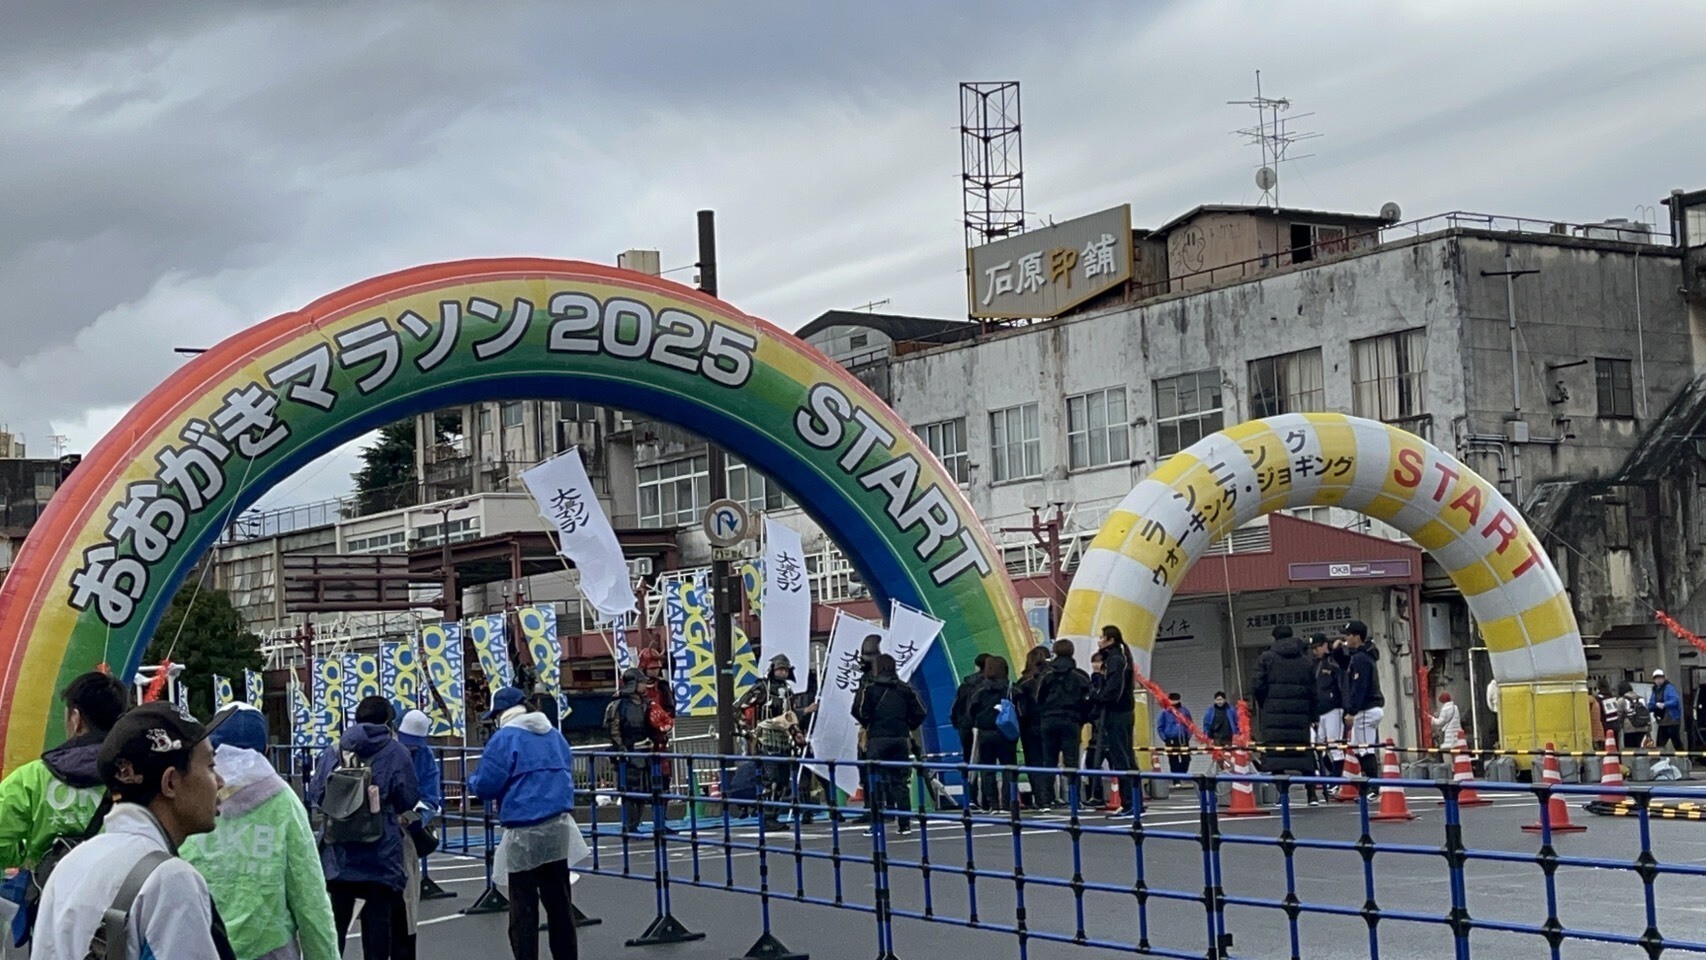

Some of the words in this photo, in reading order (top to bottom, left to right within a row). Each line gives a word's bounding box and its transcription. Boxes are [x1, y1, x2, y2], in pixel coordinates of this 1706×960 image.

[69, 297, 535, 628] おおがきマラソン
[547, 291, 757, 388] 2025
[794, 383, 992, 587] START
[1140, 429, 1307, 546] ランニング
[1152, 455, 1355, 587] ウォーキング・ジョギング
[1393, 448, 1545, 579] START
[382, 645, 396, 703] MARA
[667, 584, 692, 715] MARATHON
[680, 583, 718, 715] OGAKI
